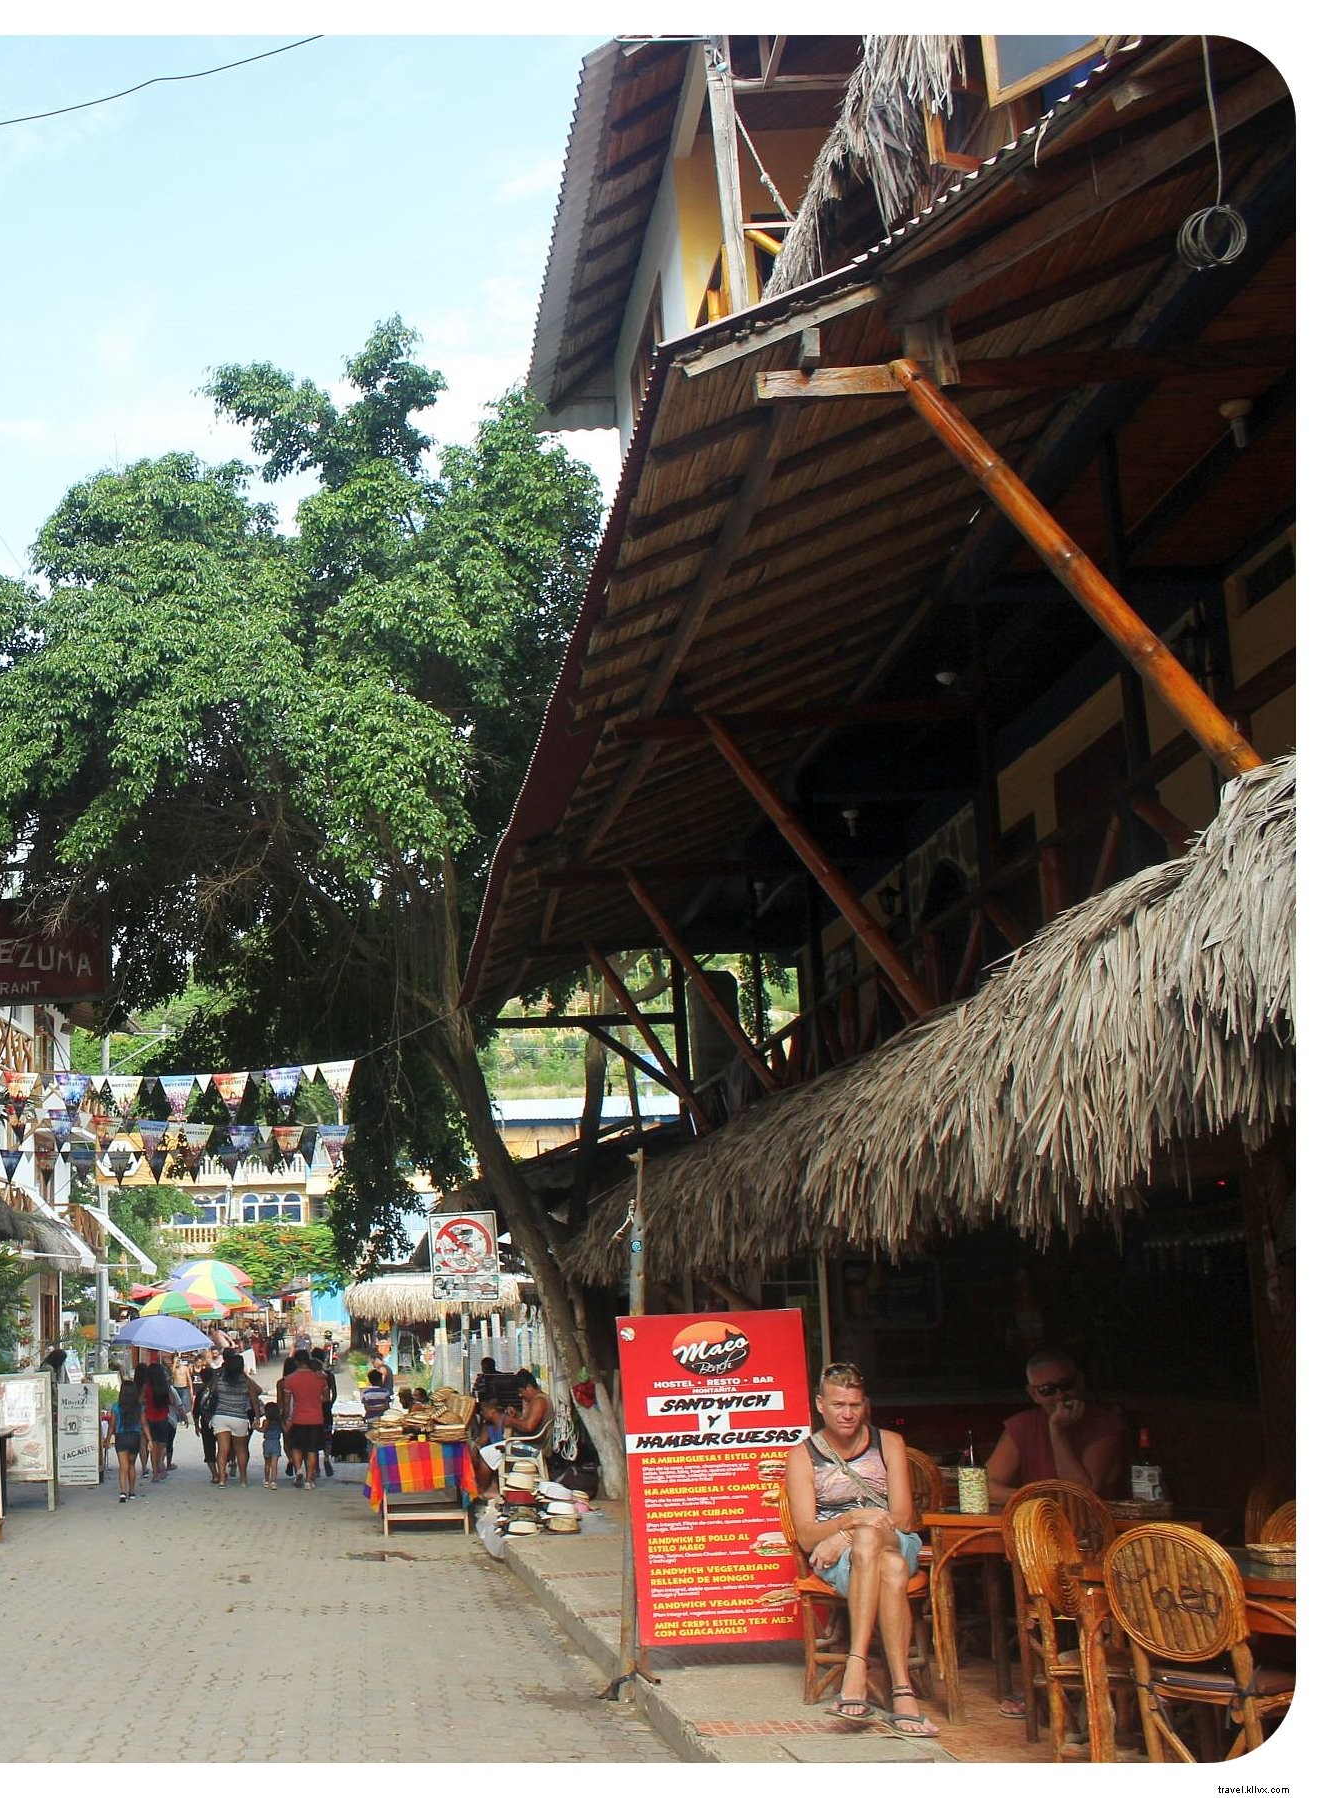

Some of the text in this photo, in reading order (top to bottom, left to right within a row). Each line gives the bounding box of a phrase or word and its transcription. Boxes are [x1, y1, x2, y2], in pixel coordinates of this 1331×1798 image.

[653, 1376, 774, 1389] HOSTEL RESTO BAR
[660, 1394, 771, 1413] SANDWICH
[68, 1421, 77, 1432] 10
[707, 1414, 721, 1428] Y
[635, 1429, 802, 1449] HAMBURGUESAS
[642, 1454, 722, 1465] HAMBURGUESAS
[725, 1452, 757, 1461] ESTILO
[644, 1485, 724, 1496] HAMBURGUESAS
[646, 1508, 745, 1519] SANDWICH CUBANO
[648, 1533, 750, 1545] SANDWICH DE POLLO AL
[648, 1544, 705, 1553] ESTILO MAEO
[650, 1563, 780, 1576] SANDWICH VEGETARIANO
[650, 1574, 755, 1586] RELLENO DE HONGOS
[653, 1598, 754, 1610] SANDWICH VEGANO
[654, 1616, 794, 1630] MINI CREPS ESTILO TEX MEX
[654, 1626, 748, 1637] CON GUACAMOLES
